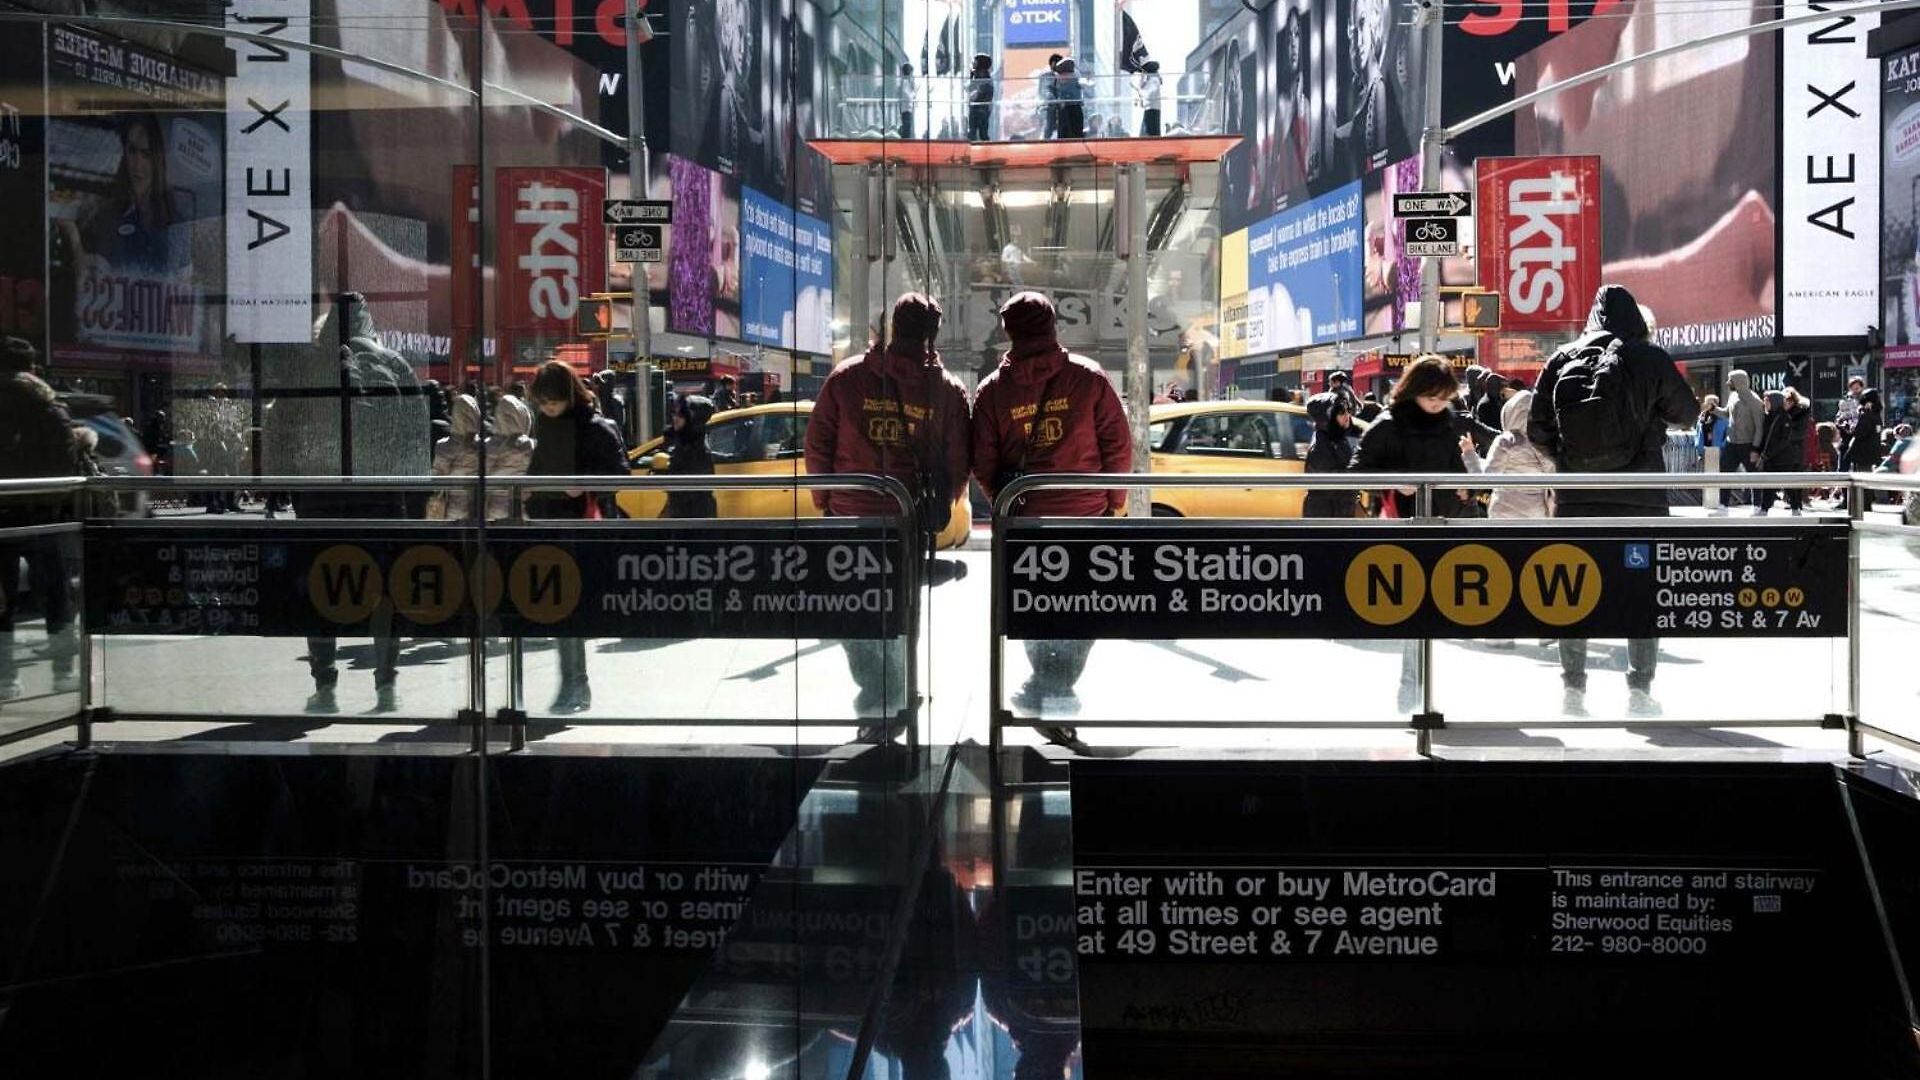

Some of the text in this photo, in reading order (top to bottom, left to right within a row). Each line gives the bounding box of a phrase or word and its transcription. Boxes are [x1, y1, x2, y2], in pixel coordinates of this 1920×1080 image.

[1022, 10, 1062, 24] TDK
[1328, 199, 1346, 226] locals
[1404, 199, 1459, 210] ONE WAY
[1409, 243, 1454, 254] BIKE LANE
[1508, 170, 1581, 315] tkts
[1788, 289, 1875, 298] AMERICAN EAGLE
[1687, 314, 1775, 346] OUTFITTERS
[1013, 545, 1304, 581] 49 St Station
[1656, 544, 1767, 561] Elevator to
[1367, 564, 1586, 606] N R W
[1656, 565, 1756, 587] Uptown &
[1013, 588, 1321, 616] Downtown & Brooklyn
[1656, 589, 1734, 608] Queens
[1657, 611, 1821, 629] at 49 St & 7 Av
[1076, 871, 1497, 901] Enter with or buy MetroCard
[1552, 870, 1815, 894] This entrance and stairway
[1552, 891, 1716, 913] is maintained by:
[1077, 900, 1443, 931] at all times or see agent
[1551, 911, 1733, 934] Sherwood Equities
[1077, 930, 1438, 954] at 49 Street & 7 Avenue
[1551, 936, 1707, 954] 212- 980-8000
